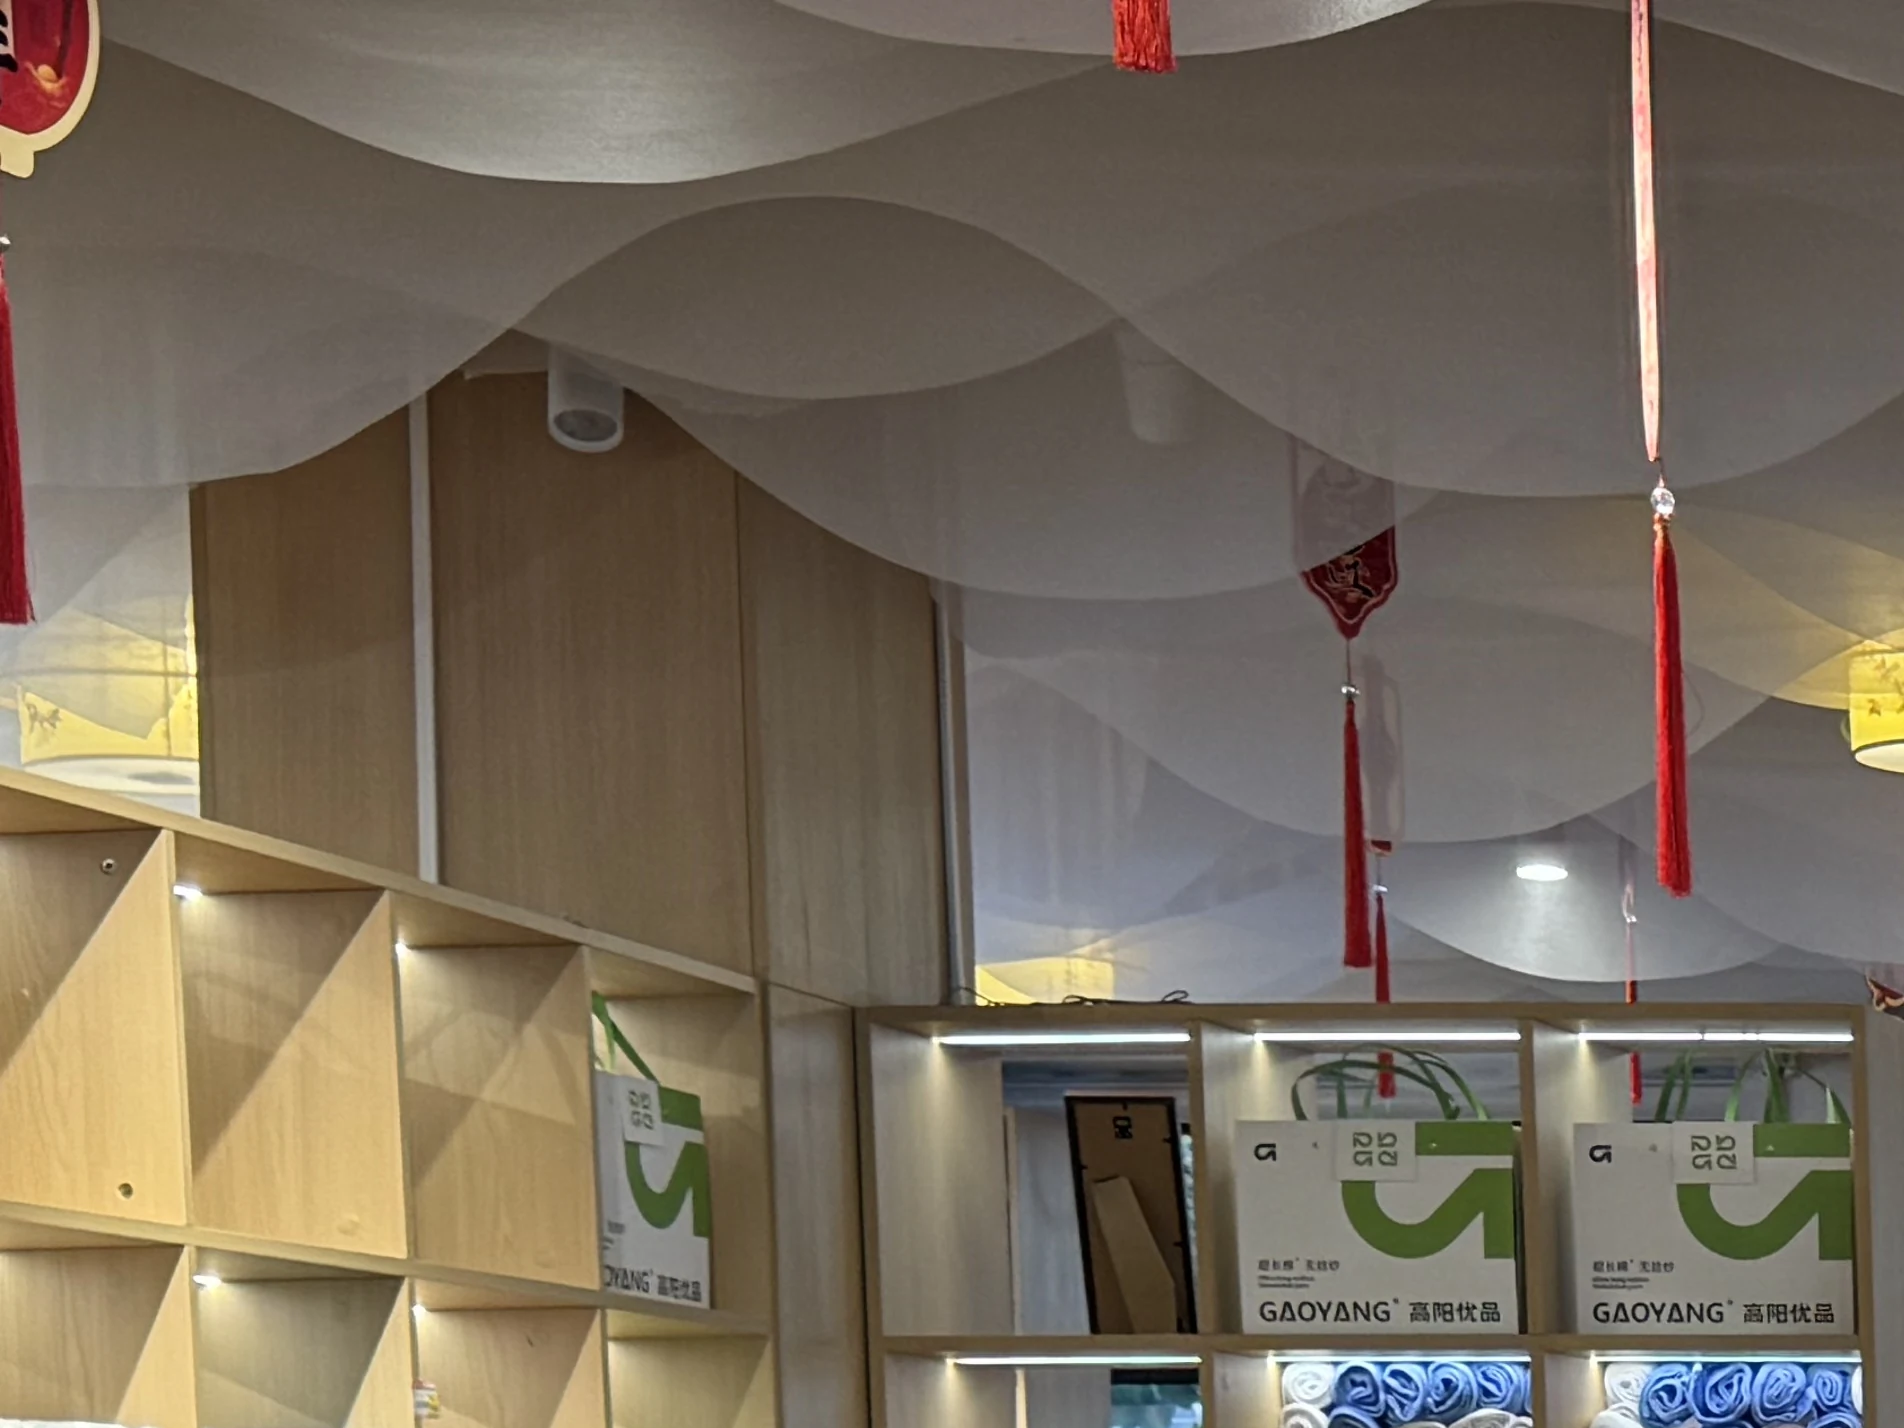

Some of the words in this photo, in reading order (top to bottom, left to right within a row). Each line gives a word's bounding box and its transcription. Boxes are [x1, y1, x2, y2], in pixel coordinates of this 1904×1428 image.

[1408, 1301, 1501, 1323] 高阳优品
[1742, 1302, 1835, 1324] 高阳优品
